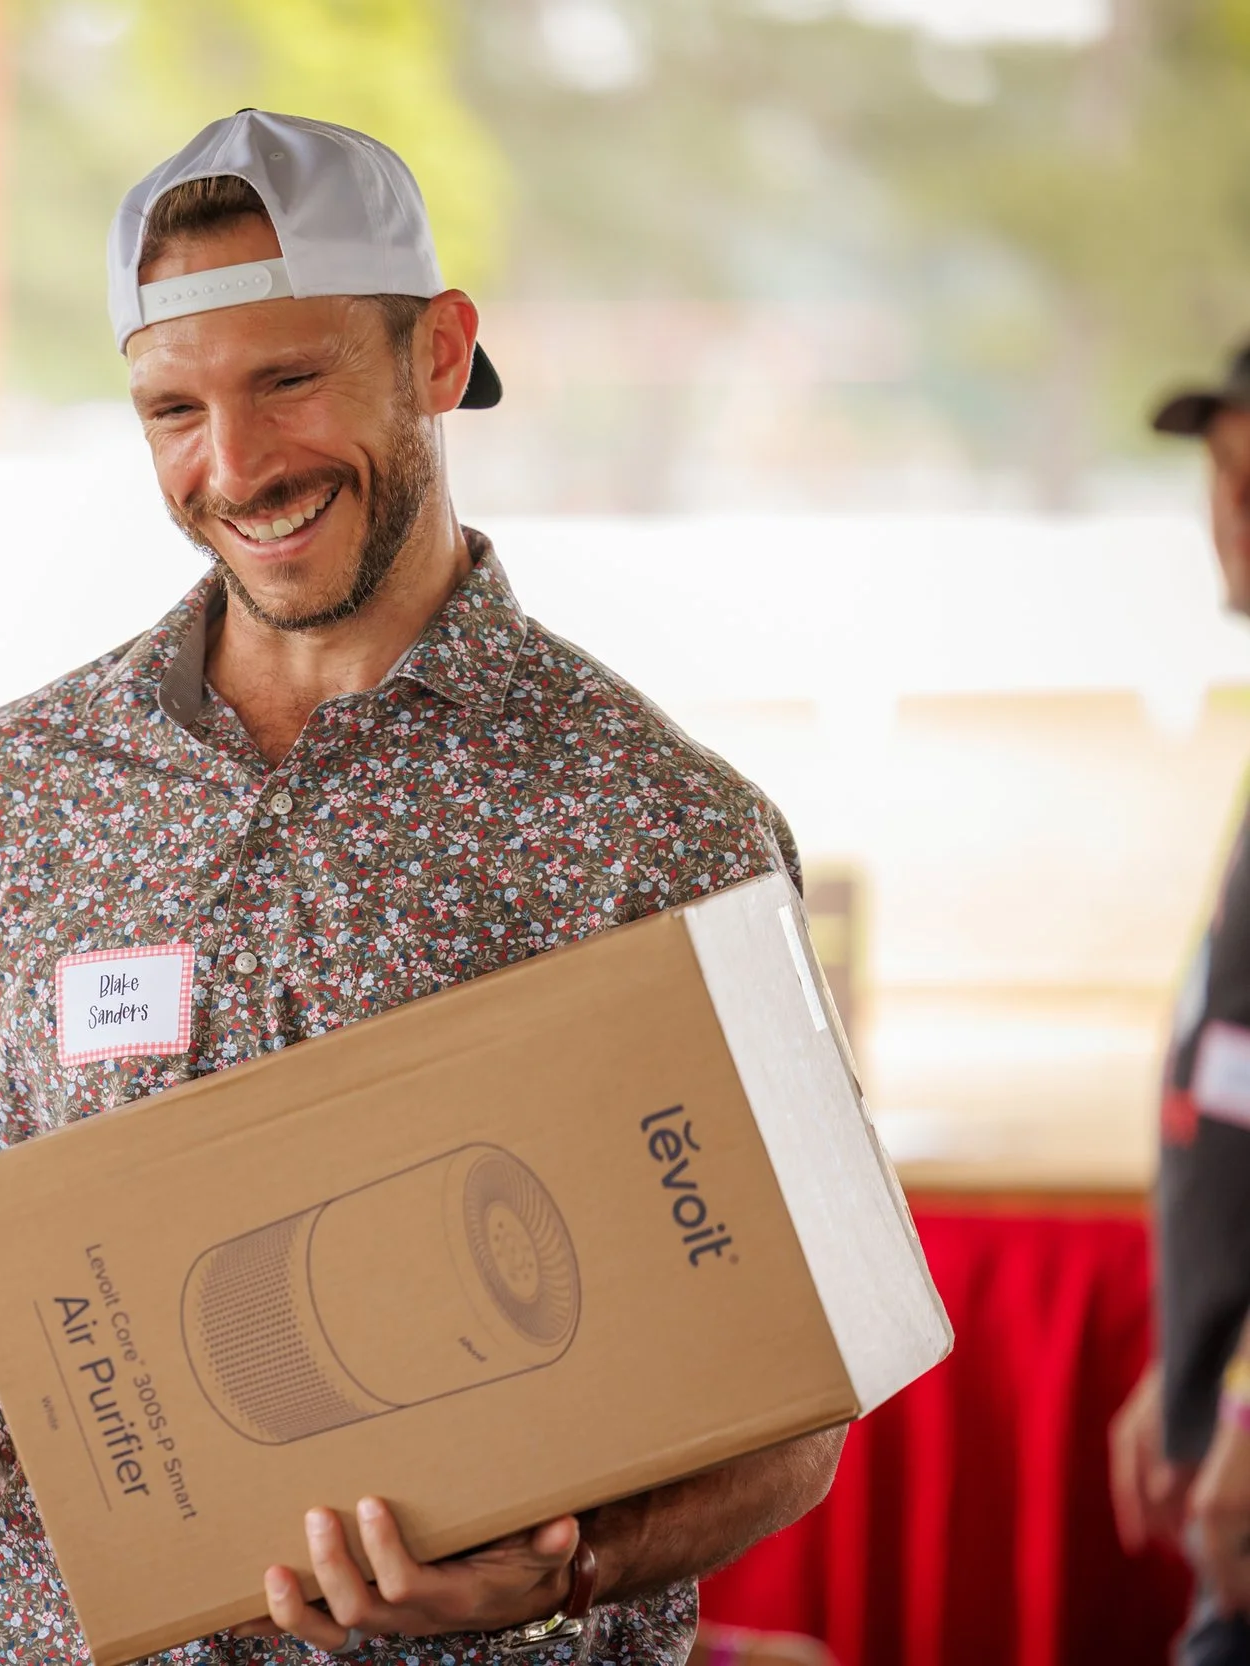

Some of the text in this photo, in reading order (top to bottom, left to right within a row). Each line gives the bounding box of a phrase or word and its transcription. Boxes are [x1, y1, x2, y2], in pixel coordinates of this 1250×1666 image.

[88, 1003, 149, 1030] Sanders
[99, 973, 140, 999] Blake
[53, 1297, 150, 1496] Air Purifier
[85, 1243, 120, 1307] Levoit
[133, 1373, 174, 1453] 300S-P
[163, 1457, 198, 1521] Smart
